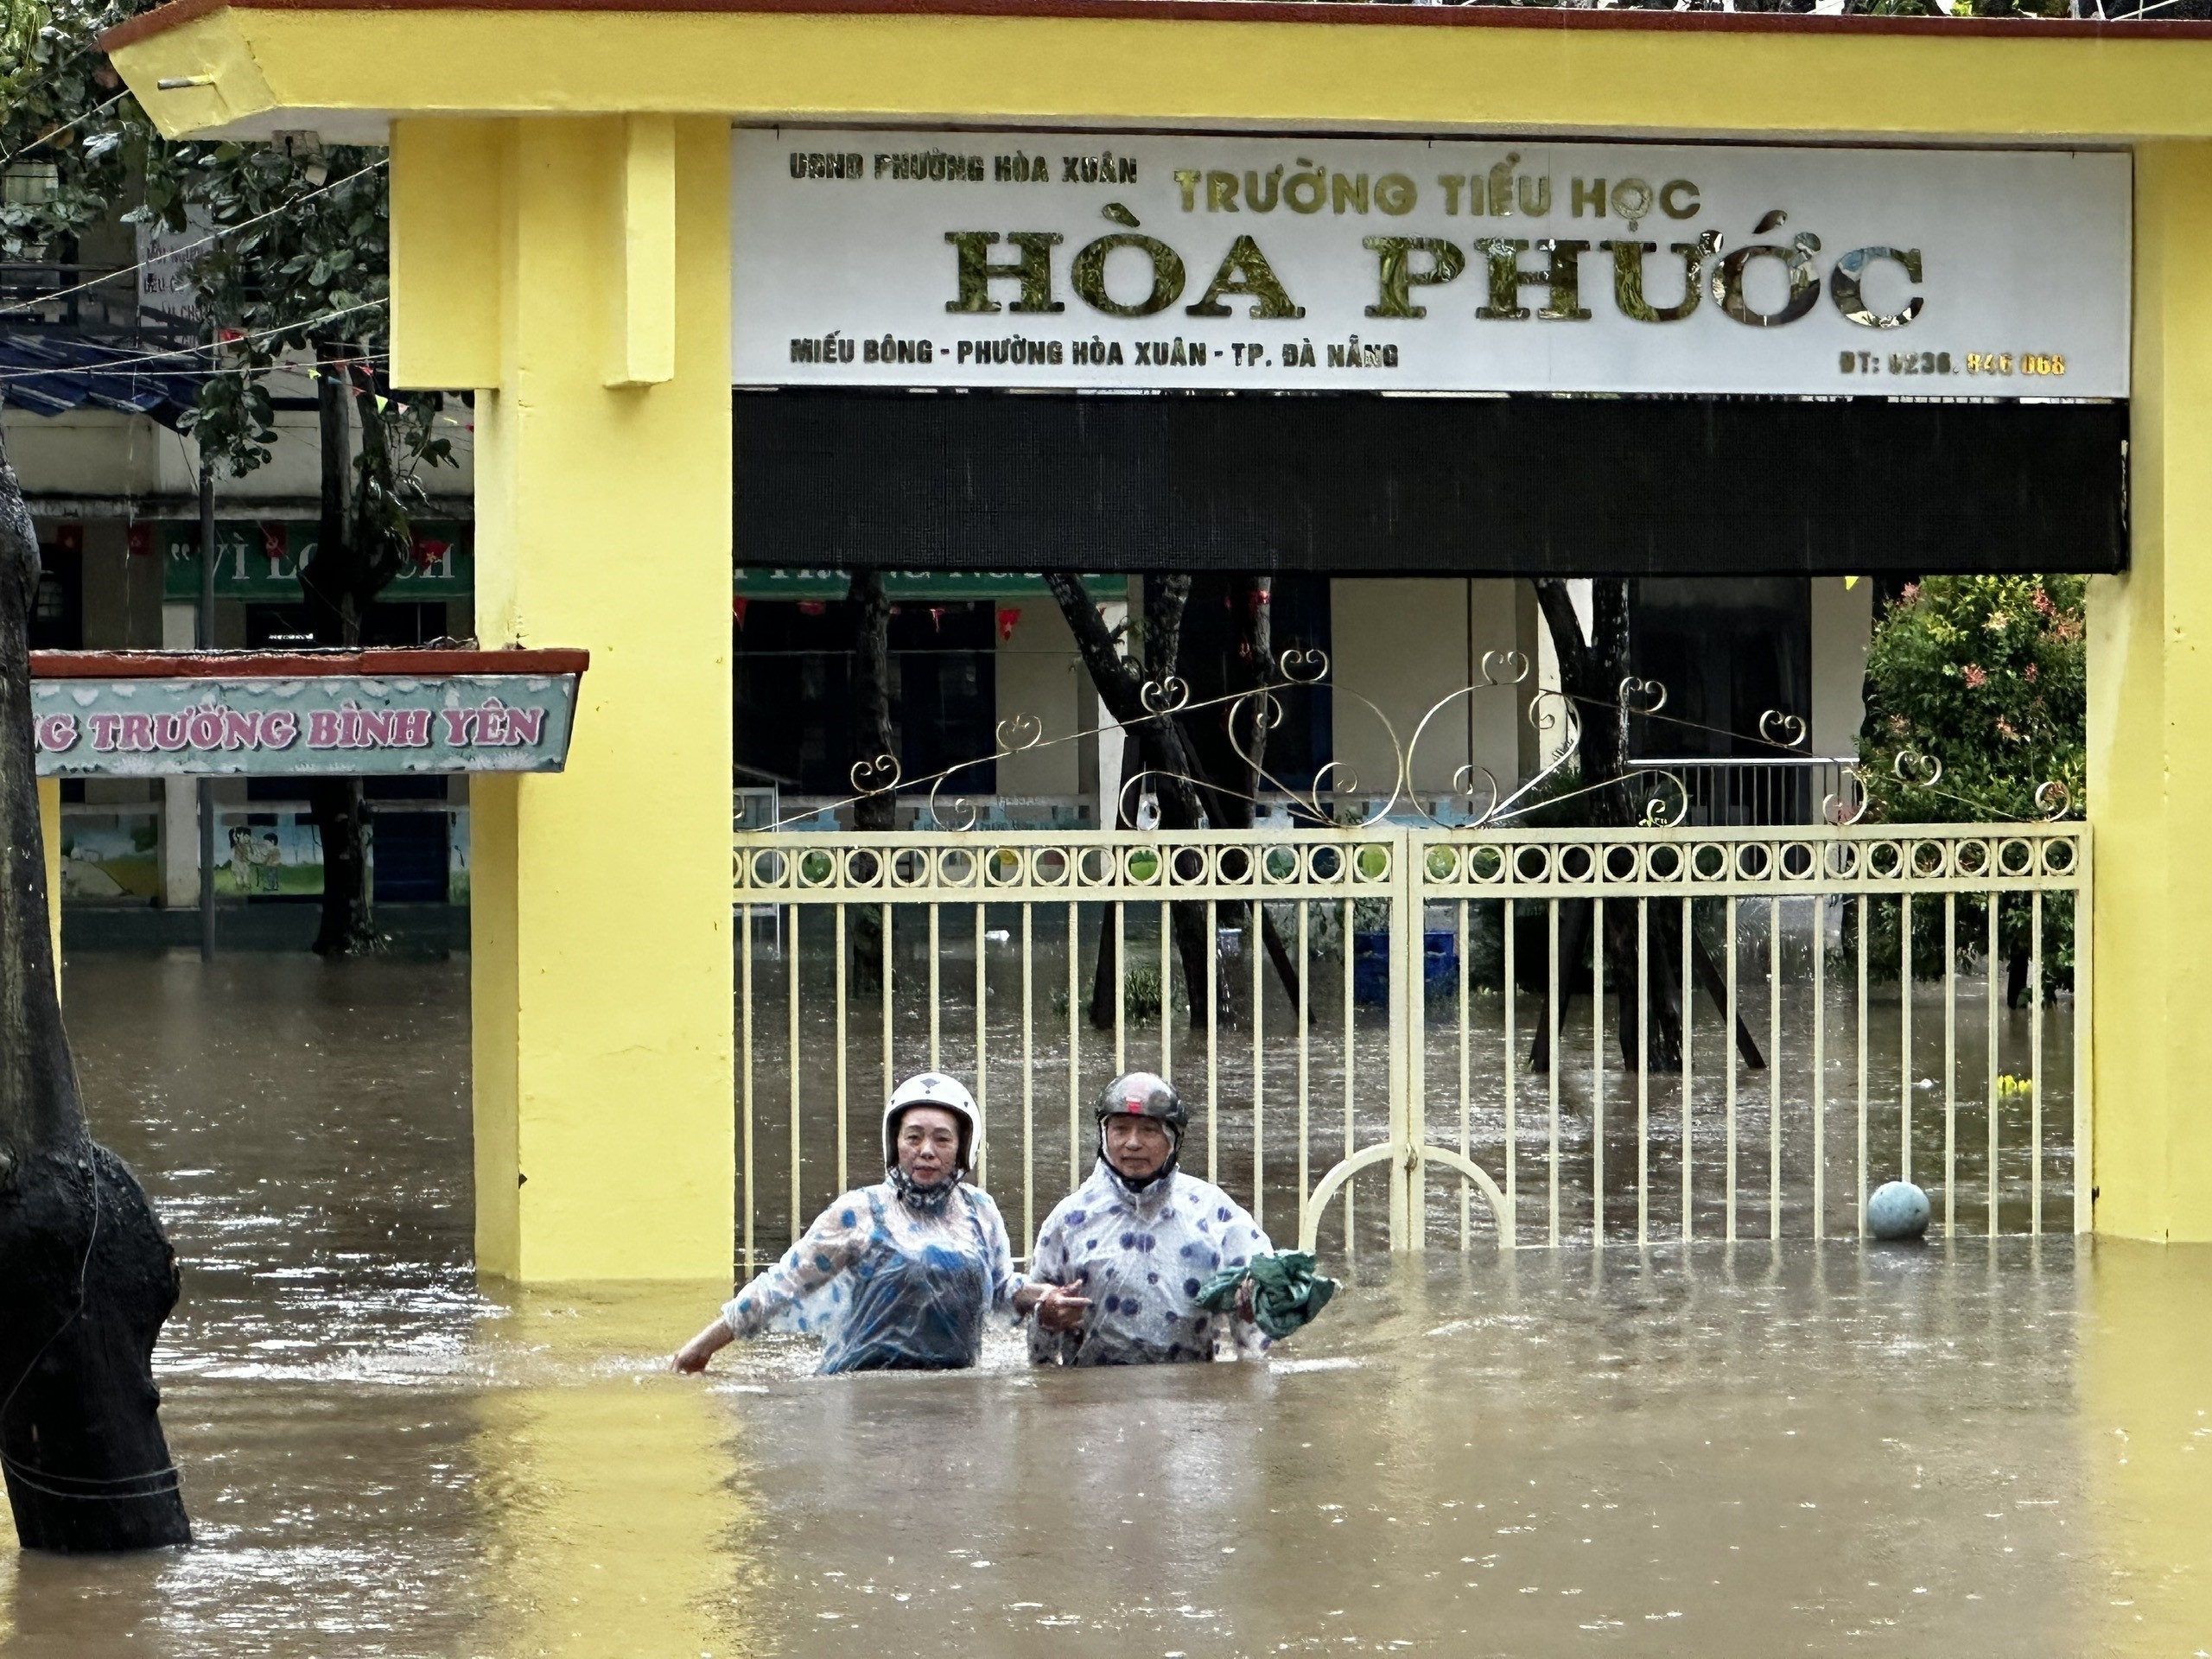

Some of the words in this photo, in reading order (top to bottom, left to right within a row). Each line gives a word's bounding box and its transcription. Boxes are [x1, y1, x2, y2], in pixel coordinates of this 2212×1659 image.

[790, 152, 863, 180] UBND
[874, 147, 984, 181] PHƯỜNG
[995, 149, 1049, 183] HÒA
[1062, 149, 1137, 184] XUÂN
[1174, 157, 1418, 216] TRƯỜNG
[1438, 151, 1552, 217] TIỂU
[1571, 177, 1700, 232] HỌC
[944, 202, 1306, 318] HÒA
[1362, 210, 1924, 328] PHƯỚC
[790, 330, 855, 364] MIẾU
[864, 334, 933, 365] BÔNG
[957, 334, 1064, 365] PHƯỜNG
[1072, 335, 1123, 366] HÒA
[1135, 336, 1207, 366] XUÂN
[1231, 342, 1273, 367] TP.
[1282, 338, 1317, 367] ĐÀ
[34, 713, 79, 753] G
[87, 702, 298, 752] TRƯỜNG
[305, 699, 431, 748] BÌNH
[441, 696, 544, 747] YÊN
